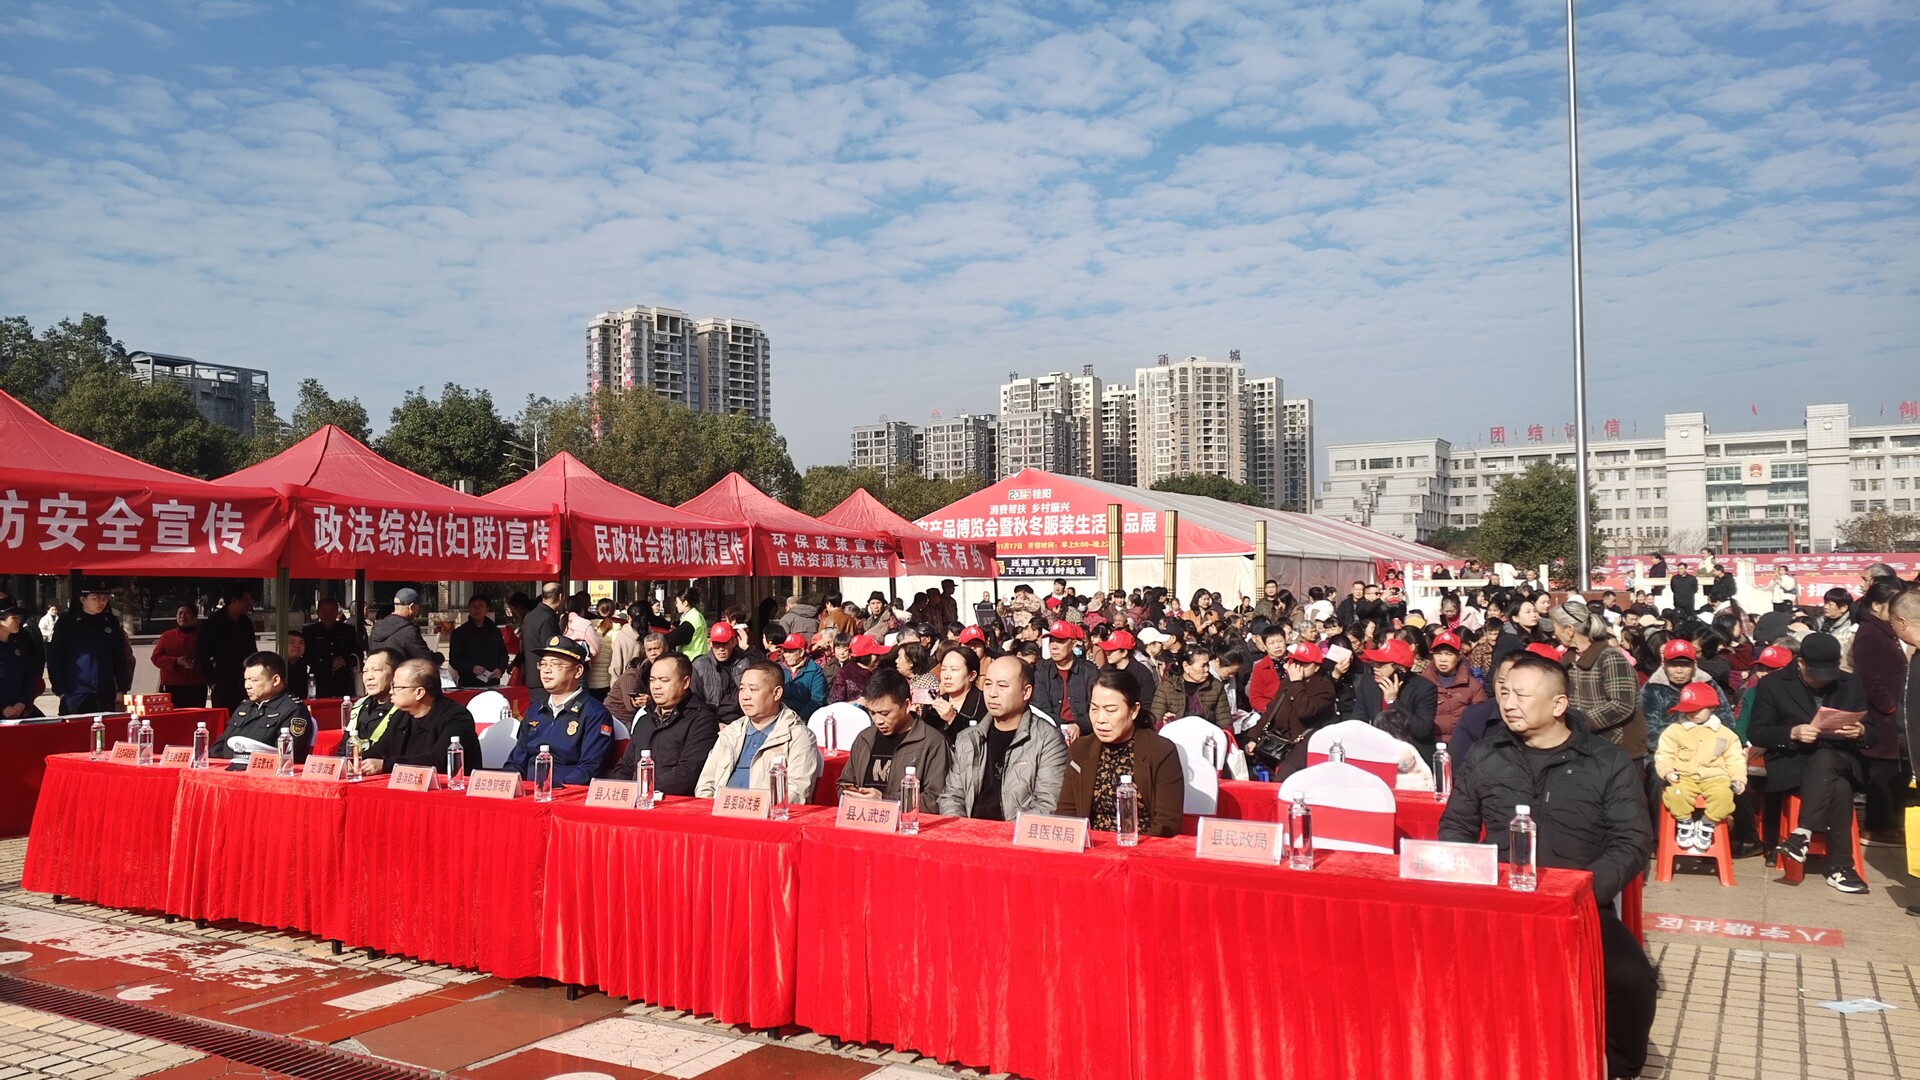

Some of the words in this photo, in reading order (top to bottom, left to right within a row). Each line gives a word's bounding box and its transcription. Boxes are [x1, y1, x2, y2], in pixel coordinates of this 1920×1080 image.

[989, 503, 1027, 515] 消费帮扶
[1031, 502, 1070, 514] 乡村振兴
[594, 525, 746, 566] 民政社会救助政策宣传
[771, 533, 885, 554] 环保政策宣传
[777, 551, 888, 570] 自然资源政策宣传
[920, 541, 985, 571] 代表有约
[594, 786, 630, 802] 县人社局
[846, 805, 890, 825] 县人武部
[1027, 823, 1075, 844] 县医保局
[1210, 829, 1268, 850] 县民政局
[1655, 916, 1828, 942] 八字塘社区
